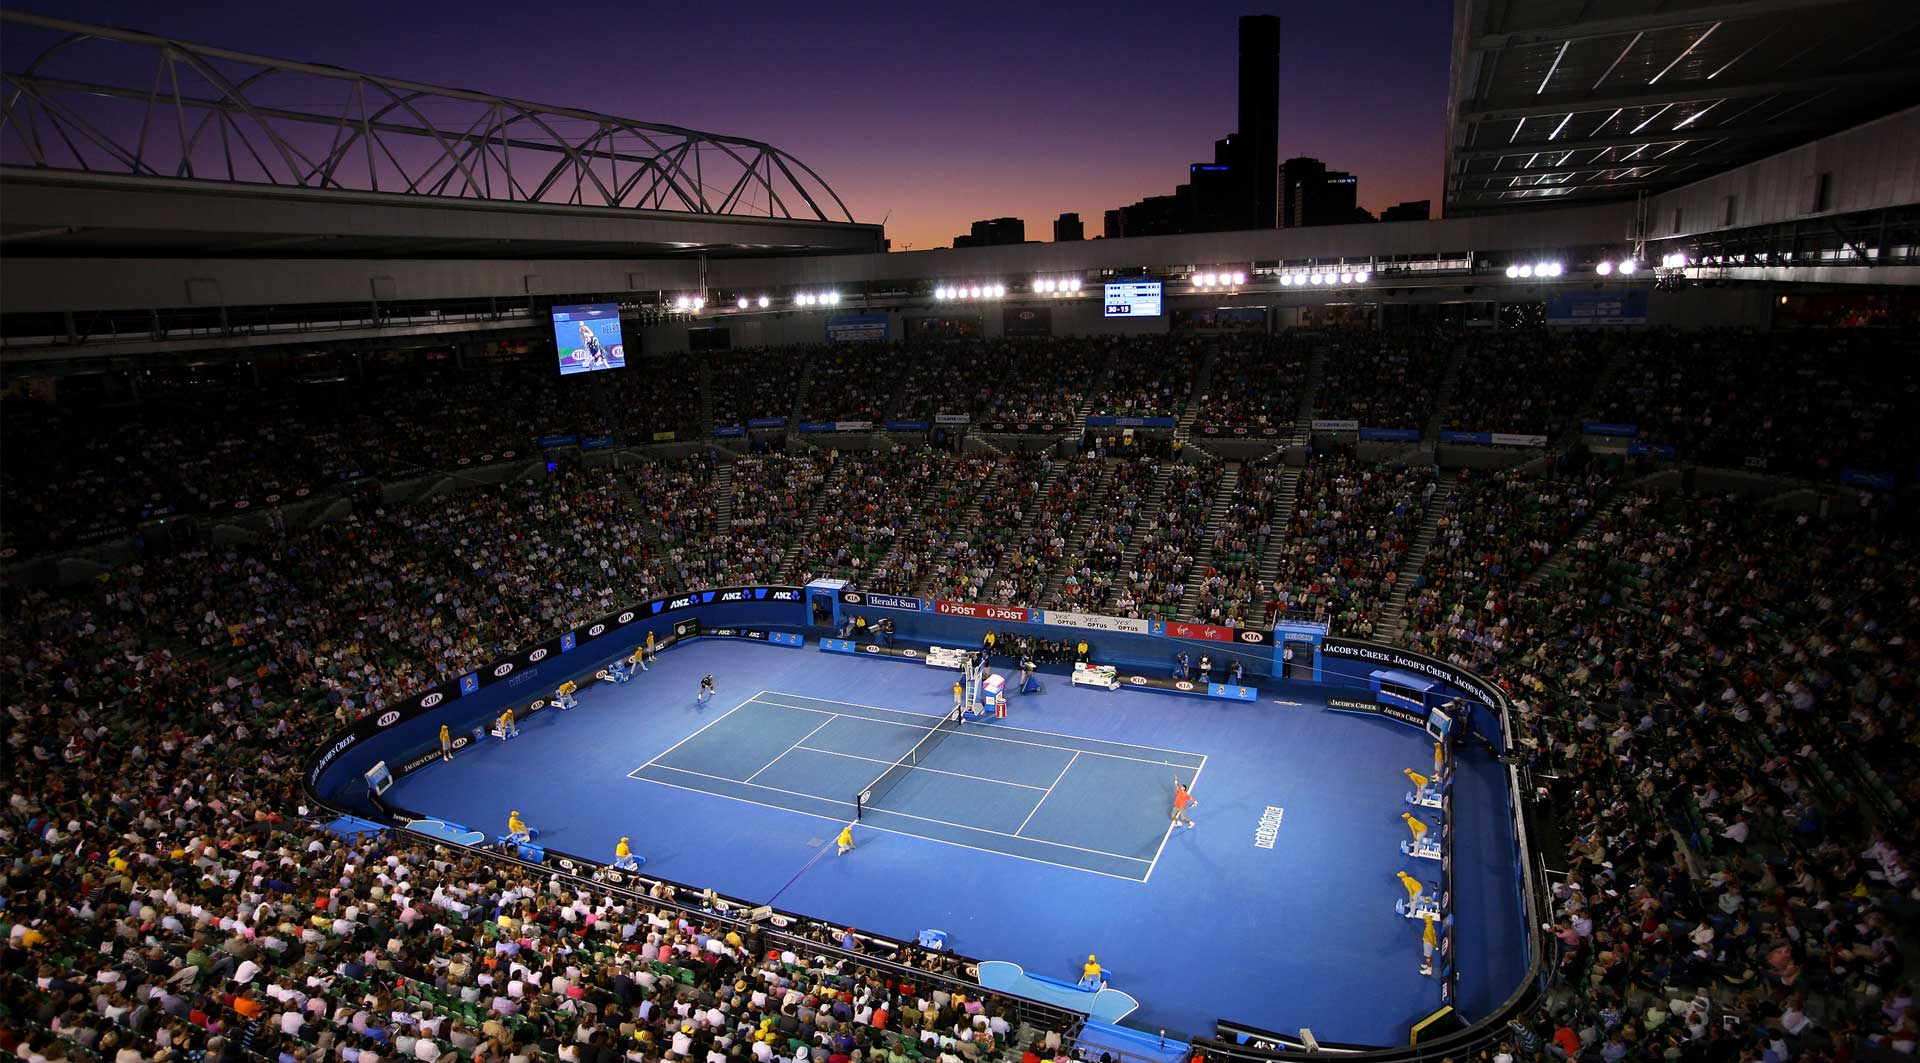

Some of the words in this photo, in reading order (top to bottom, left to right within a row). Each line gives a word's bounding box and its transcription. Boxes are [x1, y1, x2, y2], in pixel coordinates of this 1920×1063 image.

[722, 592, 742, 601] ANZ
[773, 591, 792, 600] ANZ
[845, 594, 860, 604] KIA
[670, 598, 690, 609] ANZ
[870, 596, 898, 608] Herald
[900, 600, 916, 609] Sun
[951, 606, 976, 616] POST
[997, 610, 1024, 620] POST
[619, 613, 633, 622] KIA
[590, 624, 604, 634] KIA
[1243, 632, 1261, 642] KIA
[532, 649, 546, 660] KIA
[866, 645, 880, 654] KIA
[904, 649, 918, 658] KIA
[497, 664, 512, 676] KIA
[1132, 676, 1146, 685] KIA
[1324, 643, 1358, 656] JACOB'S
[1360, 648, 1390, 662] CREEK
[1392, 655, 1426, 671] JACOB'S
[1426, 664, 1452, 682] CREEK
[1454, 676, 1479, 696] JACOB'S
[1479, 690, 1496, 710] CREEK
[1177, 681, 1192, 690] KIA
[423, 693, 441, 706] KIA
[532, 700, 544, 709] KIA
[1355, 702, 1377, 712] CREEK
[379, 712, 398, 725] KIA
[1407, 714, 1425, 727] CREEK
[335, 733, 356, 752] CREEK
[453, 738, 467, 748] KIA
[560, 860, 572, 868] KIA
[610, 873, 622, 882] KIA
[716, 901, 728, 910] KIA
[772, 916, 786, 927] KIA
